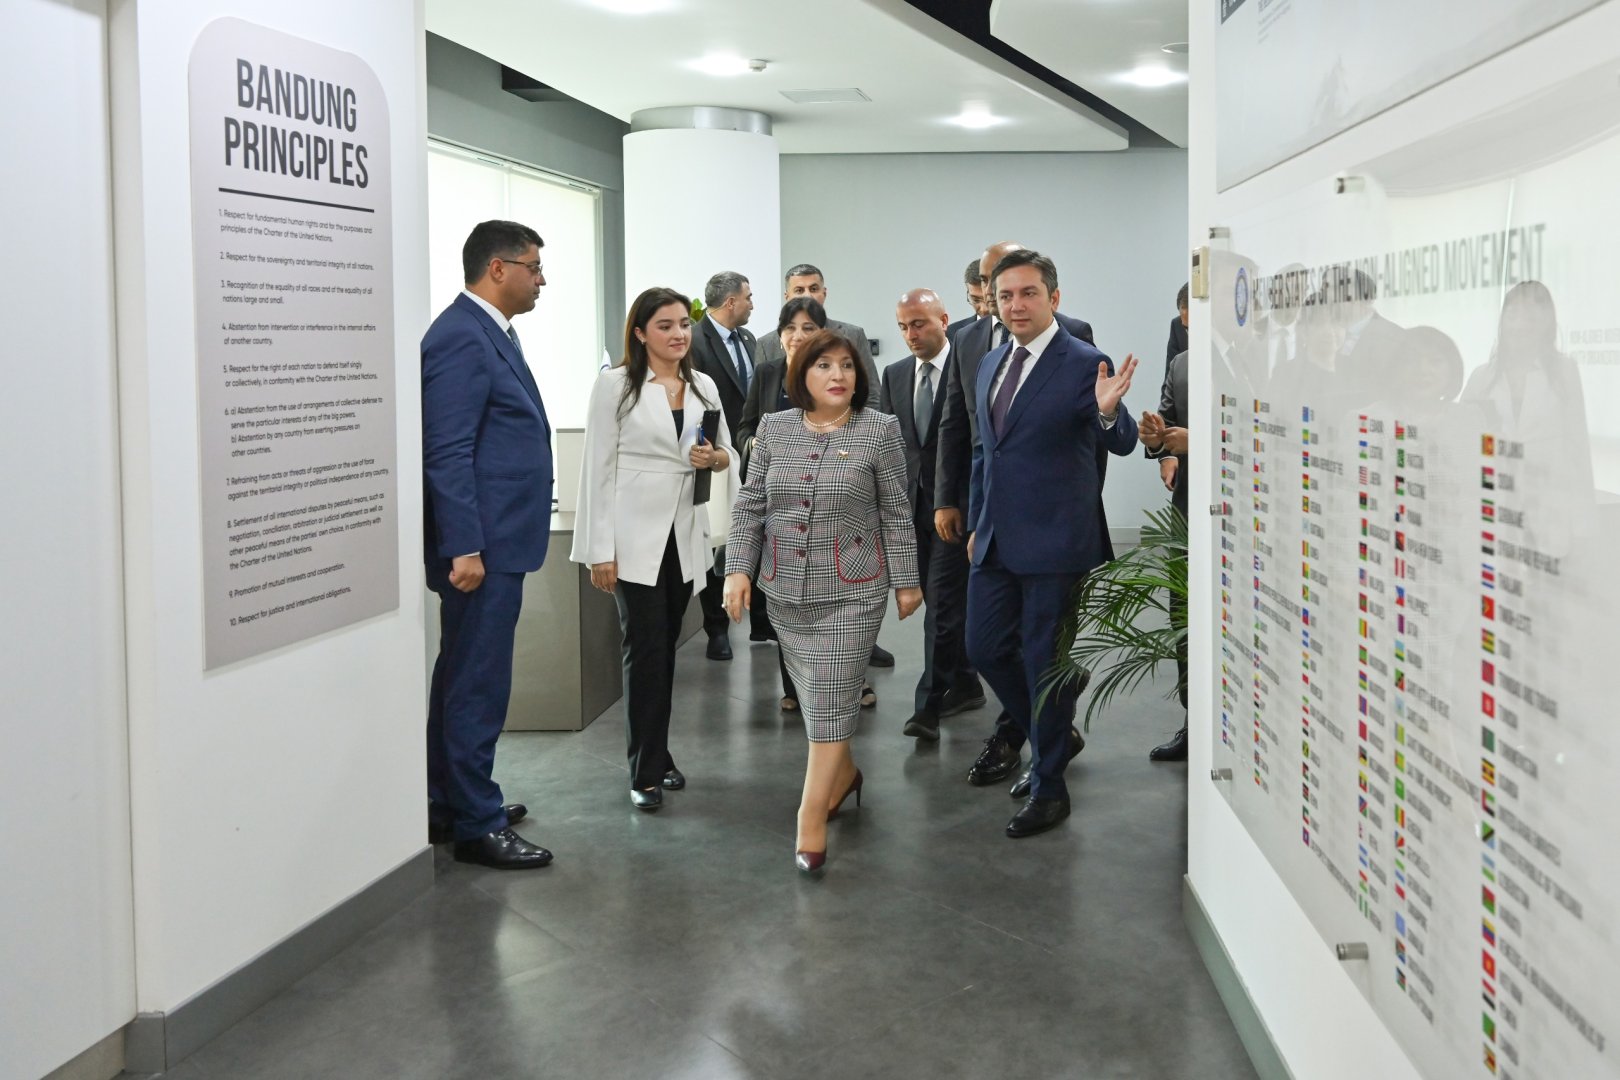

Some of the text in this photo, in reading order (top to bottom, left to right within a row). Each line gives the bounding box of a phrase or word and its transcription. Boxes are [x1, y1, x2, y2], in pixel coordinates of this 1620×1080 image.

[236, 58, 357, 133] BANDUNG
[224, 116, 369, 189] PRINCIPLES
[224, 209, 246, 219] Respect
[255, 213, 287, 224] fundamental
[288, 218, 304, 226] human
[305, 220, 318, 229] rights
[220, 224, 247, 234] principles
[264, 228, 283, 237] Charter
[299, 232, 314, 240] United
[226, 252, 248, 262] Respect
[267, 257, 295, 266] sovereignty
[1285, 268, 1316, 308] STATES
[1318, 265, 1329, 306] OF
[1333, 260, 1352, 303] THE
[1355, 244, 1439, 301] NON-ALIGNED
[1444, 223, 1546, 292] MOVEMENT
[227, 280, 258, 291] Recognition
[275, 284, 295, 292] equality
[244, 295, 258, 305] large
[228, 323, 257, 331] Abstention
[229, 365, 251, 373] Respect
[269, 364, 281, 373] right
[237, 406, 265, 414] Abstention
[303, 401, 335, 410] arrangements
[256, 417, 280, 428] particular
[238, 434, 266, 442] Abstention
[266, 432, 273, 440] by
[232, 449, 246, 458] other
[231, 476, 258, 485] Refraining
[289, 468, 306, 476] threats
[228, 490, 248, 502] against
[283, 482, 303, 492] integrity
[233, 516, 262, 527] Settlement
[263, 513, 269, 522] of
[277, 506, 307, 519] international
[293, 518, 318, 529] arbitration
[229, 548, 244, 556] other
[245, 541, 268, 554] peaceful
[268, 539, 285, 547] means
[240, 558, 260, 568] Charter
[261, 554, 267, 563] of
[277, 549, 293, 560] United
[234, 585, 261, 597] Promotion
[268, 577, 286, 588] mutual
[286, 573, 306, 583] interests
[307, 569, 316, 578] and
[238, 612, 260, 624] Respect
[268, 606, 285, 617] justice
[285, 602, 296, 611] and
[296, 592, 325, 607] international
